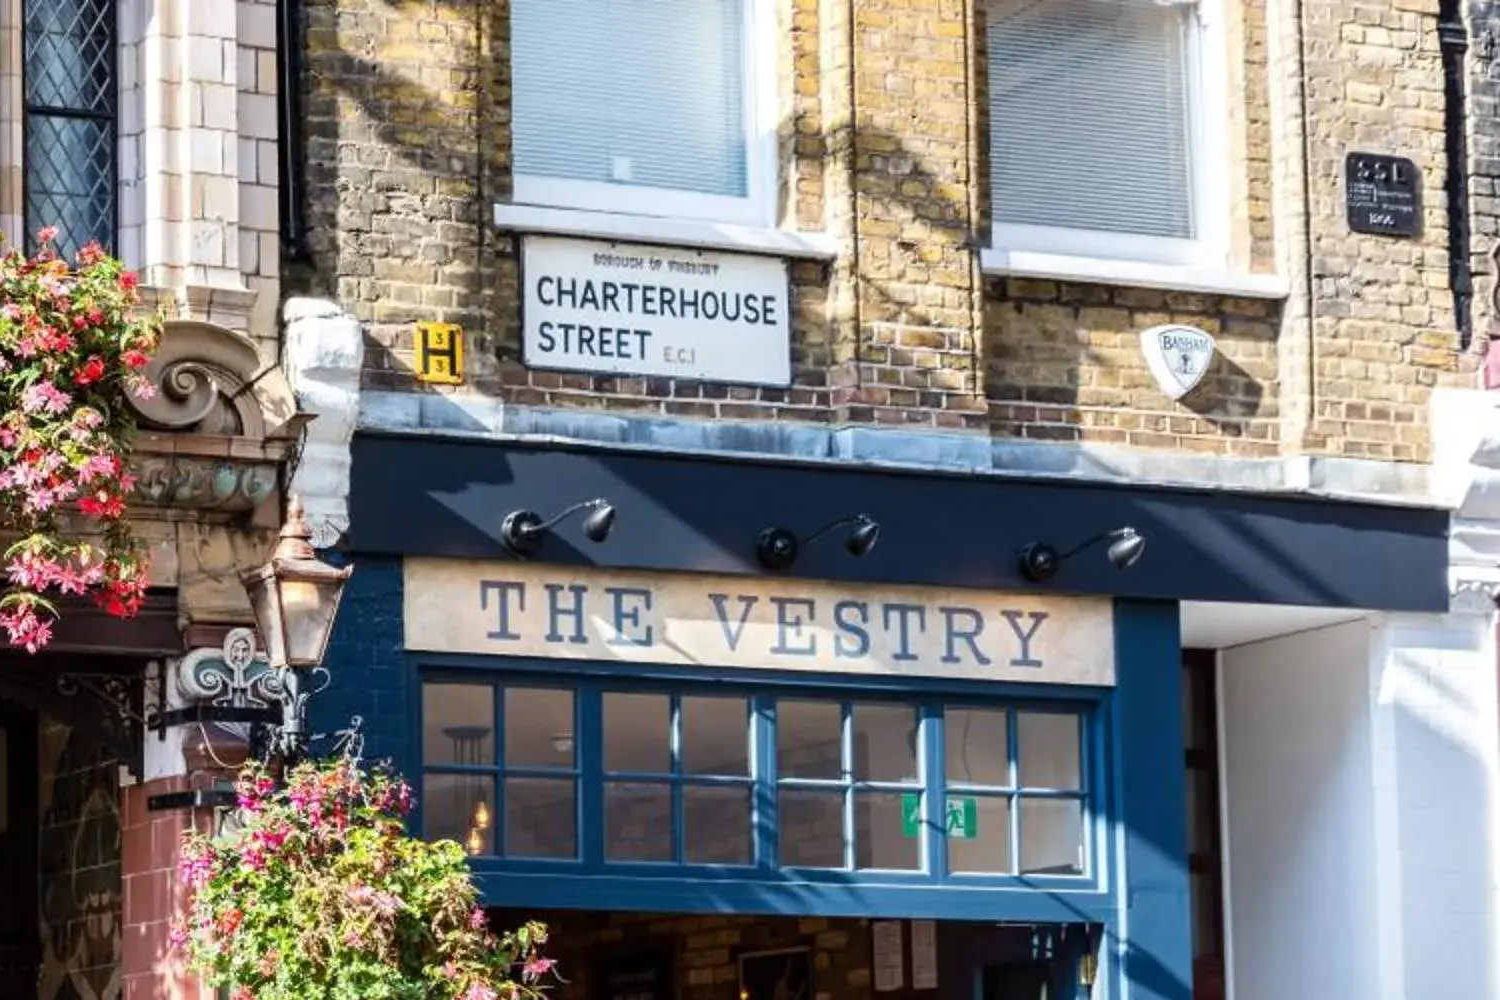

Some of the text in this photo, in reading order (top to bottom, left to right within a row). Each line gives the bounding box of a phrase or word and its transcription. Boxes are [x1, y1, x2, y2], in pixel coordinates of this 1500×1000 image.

[536, 275, 778, 326] CHARTERHOUSE
[537, 320, 653, 361] STREET
[480, 579, 1050, 669] THE VESTRY
